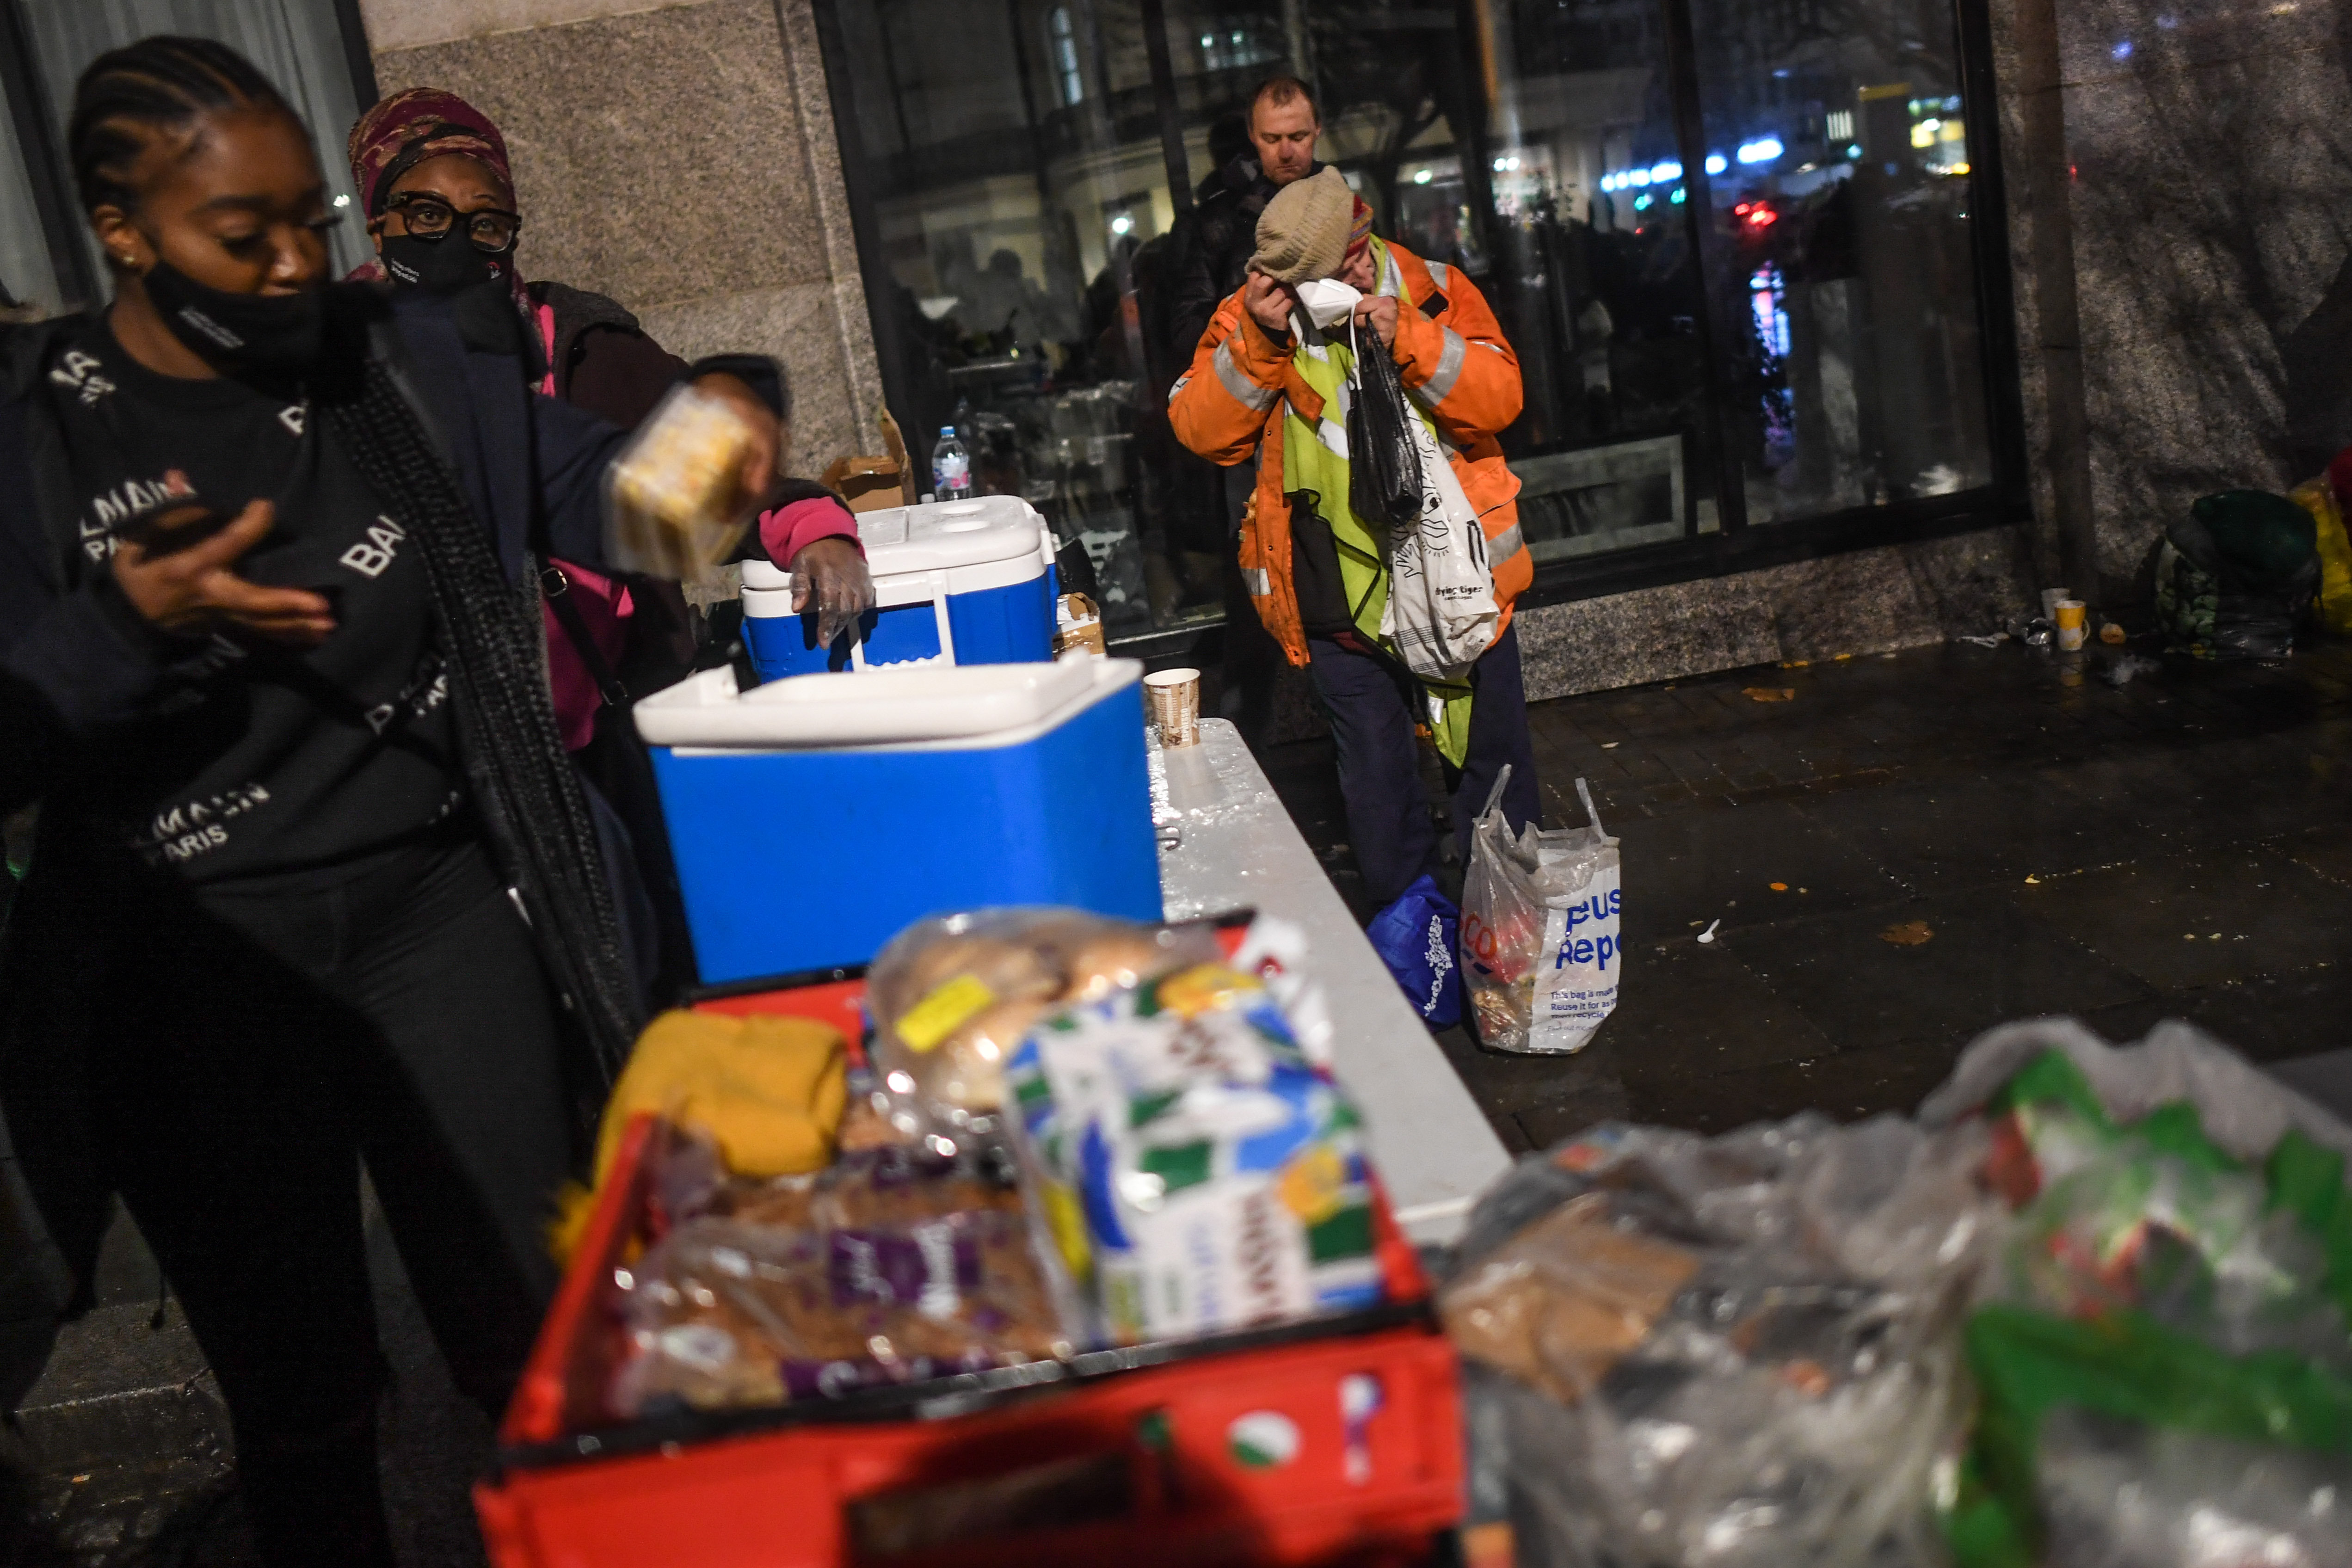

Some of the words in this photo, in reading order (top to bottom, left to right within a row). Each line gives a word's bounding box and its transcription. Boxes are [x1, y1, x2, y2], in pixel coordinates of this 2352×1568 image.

[163, 823, 229, 860] ARIS
[1570, 991, 1586, 1000] bag
[1588, 990, 1594, 998] is
[1551, 1003, 1578, 1011] Reuse
[1580, 1002, 1586, 1010] it
